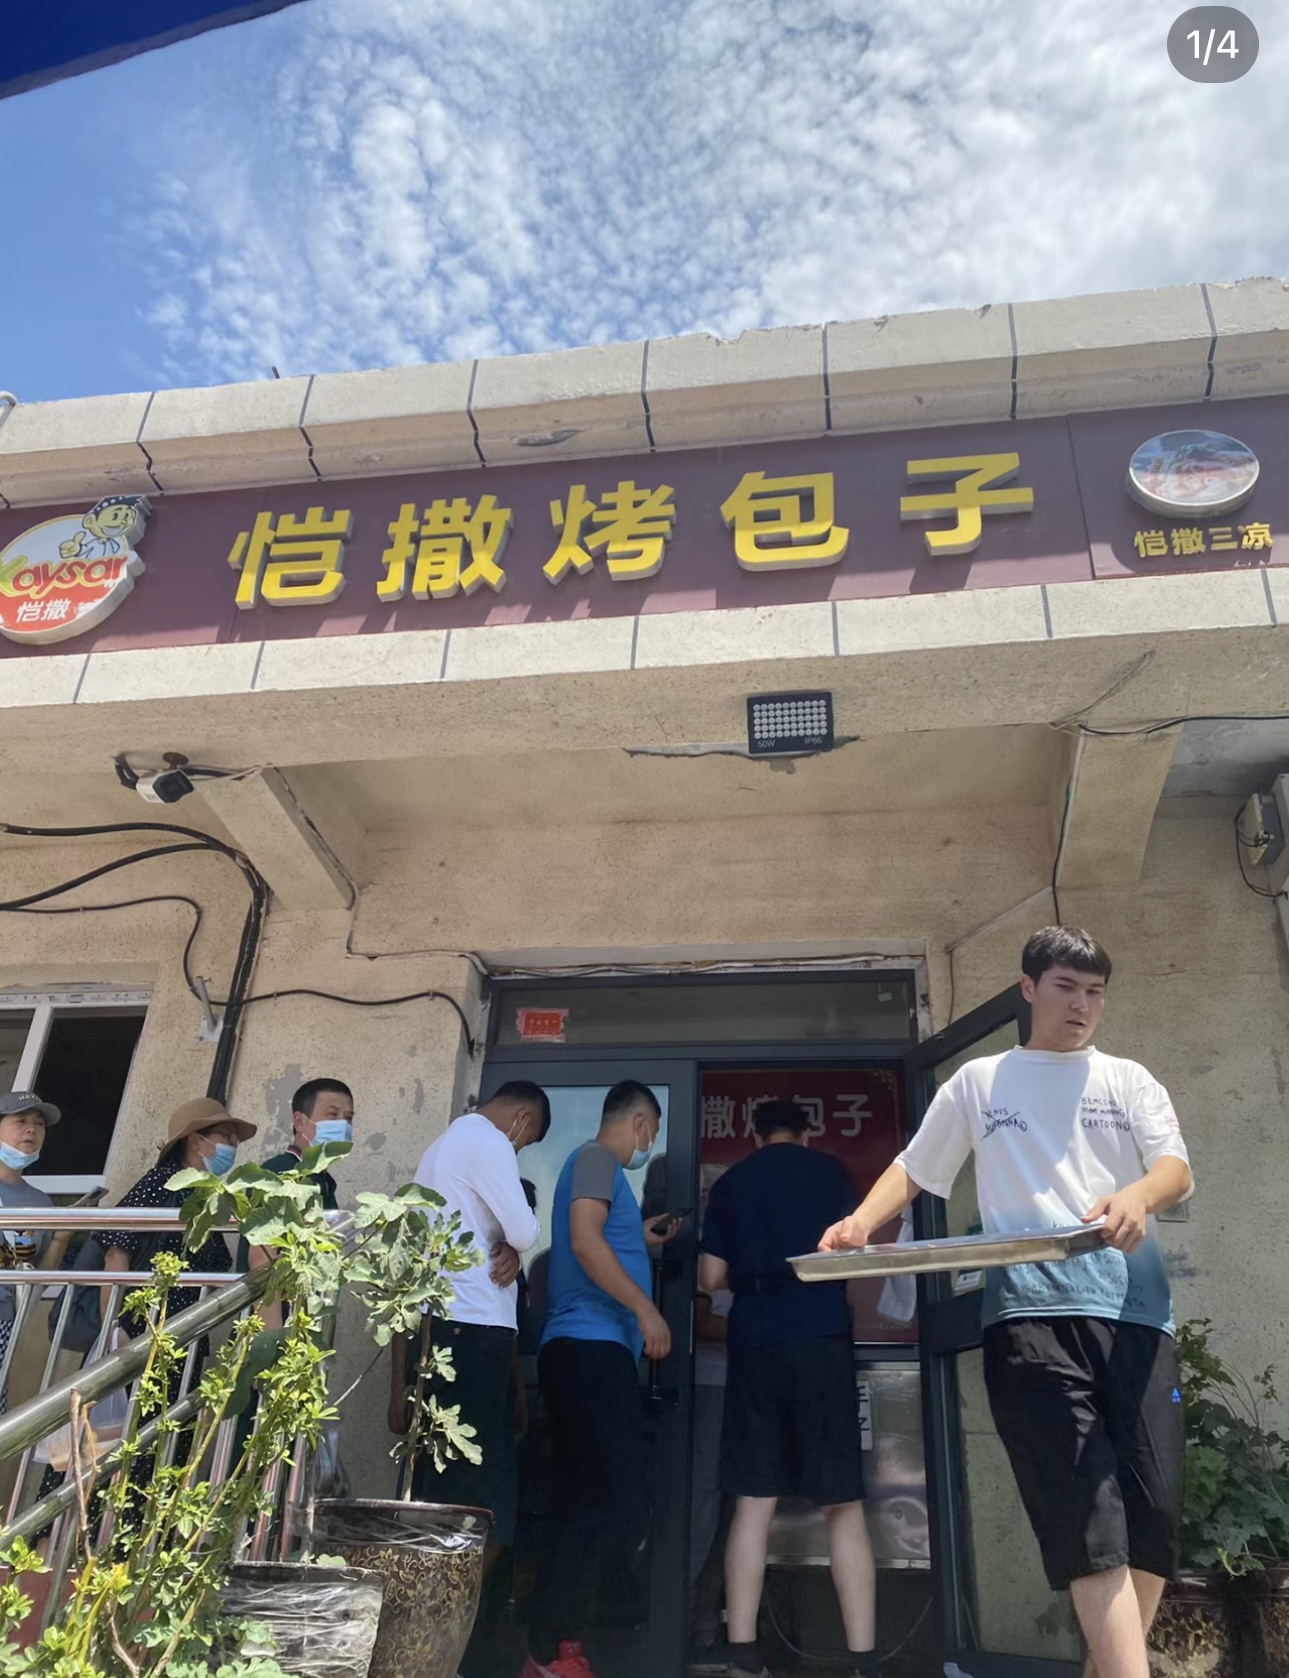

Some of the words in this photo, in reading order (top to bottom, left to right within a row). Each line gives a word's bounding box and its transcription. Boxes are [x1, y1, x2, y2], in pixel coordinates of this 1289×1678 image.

[228, 452, 1035, 608] 恺撒烤包子
